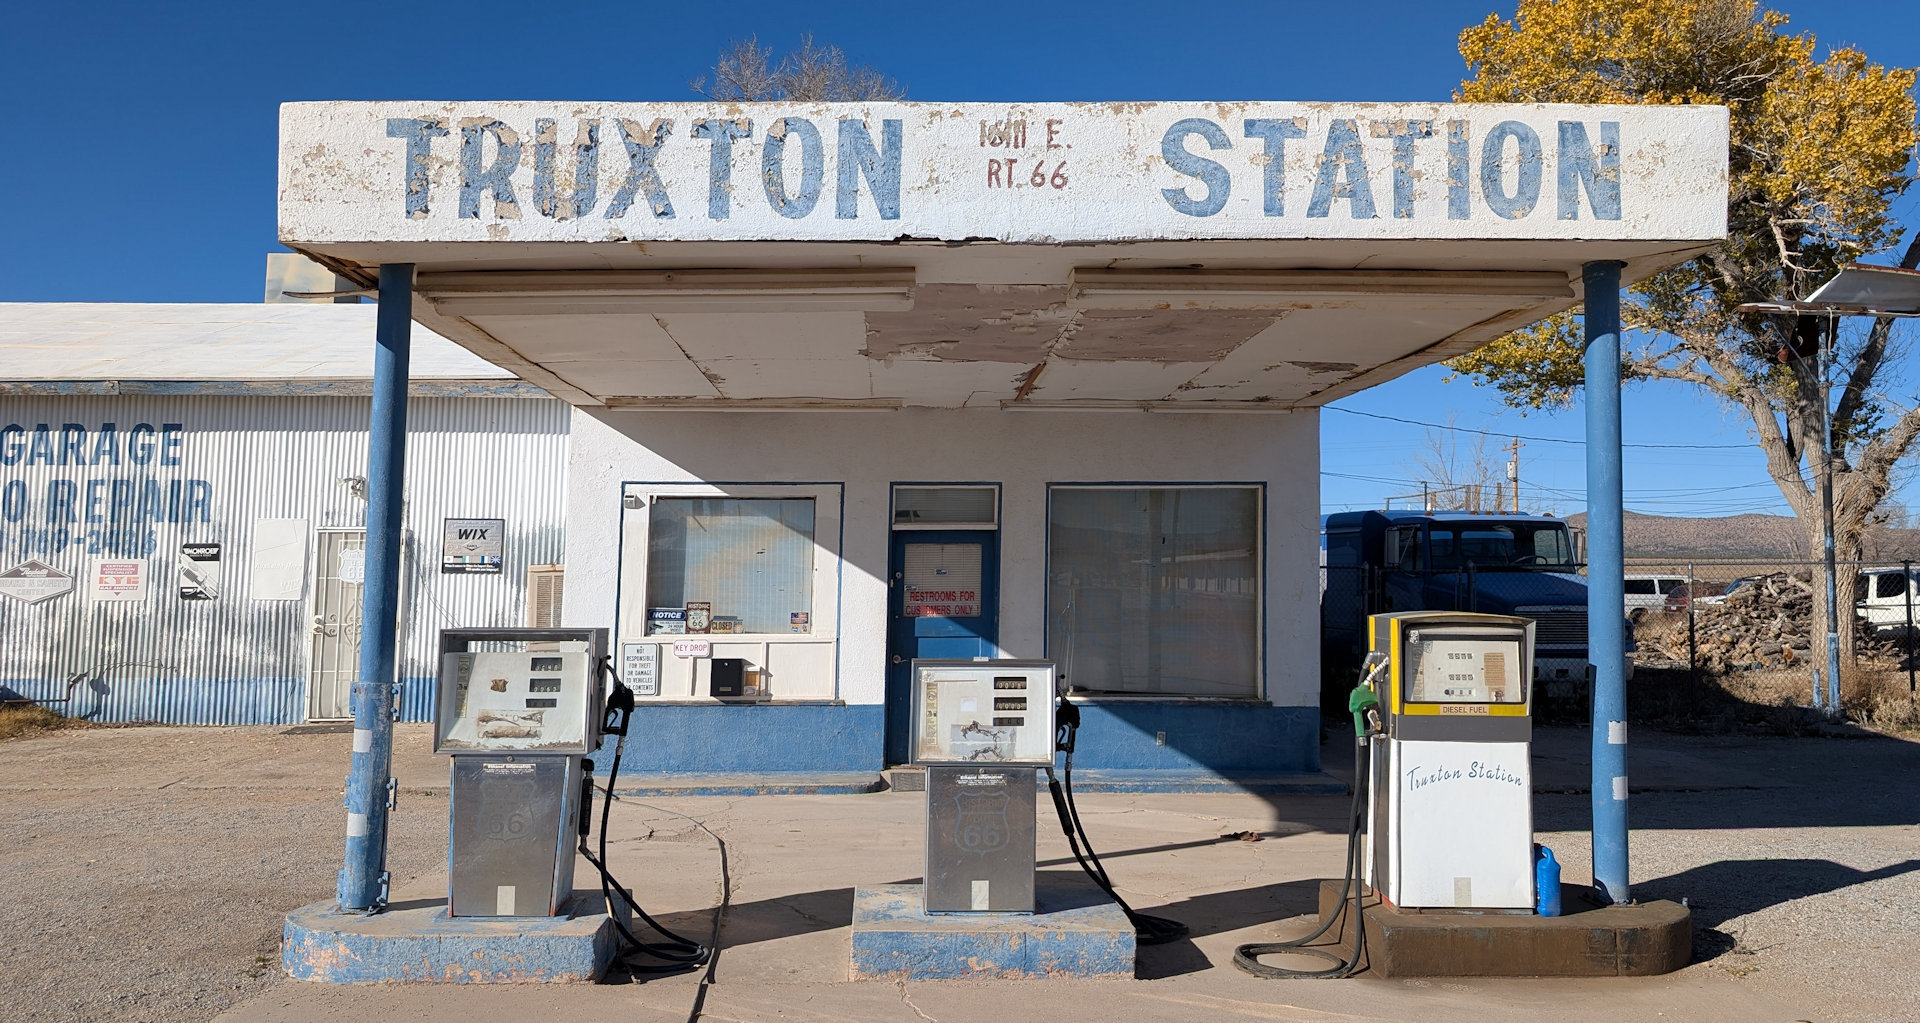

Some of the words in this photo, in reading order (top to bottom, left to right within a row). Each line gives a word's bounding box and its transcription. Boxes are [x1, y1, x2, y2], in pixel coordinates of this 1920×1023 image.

[386, 116, 903, 221] TRUXTON
[1160, 118, 1623, 222] STATION
[1030, 160, 1069, 189] 66
[0, 422, 183, 466] GARAGE
[46, 480, 213, 523] REPAIR
[458, 529, 490, 540] WIX
[910, 591, 957, 602] RESTROOMS
[960, 591, 975, 602] FOR
[652, 611, 682, 620] NOTICE
[954, 605, 973, 615] ONLY
[711, 621, 733, 630] CLOSED
[1442, 706, 1467, 714] DIESEL
[1469, 706, 1487, 714] FUEL
[1406, 764, 1463, 792] Truxton
[1468, 760, 1523, 787] Station
[488, 812, 524, 834] 66
[963, 824, 1000, 846] 66
